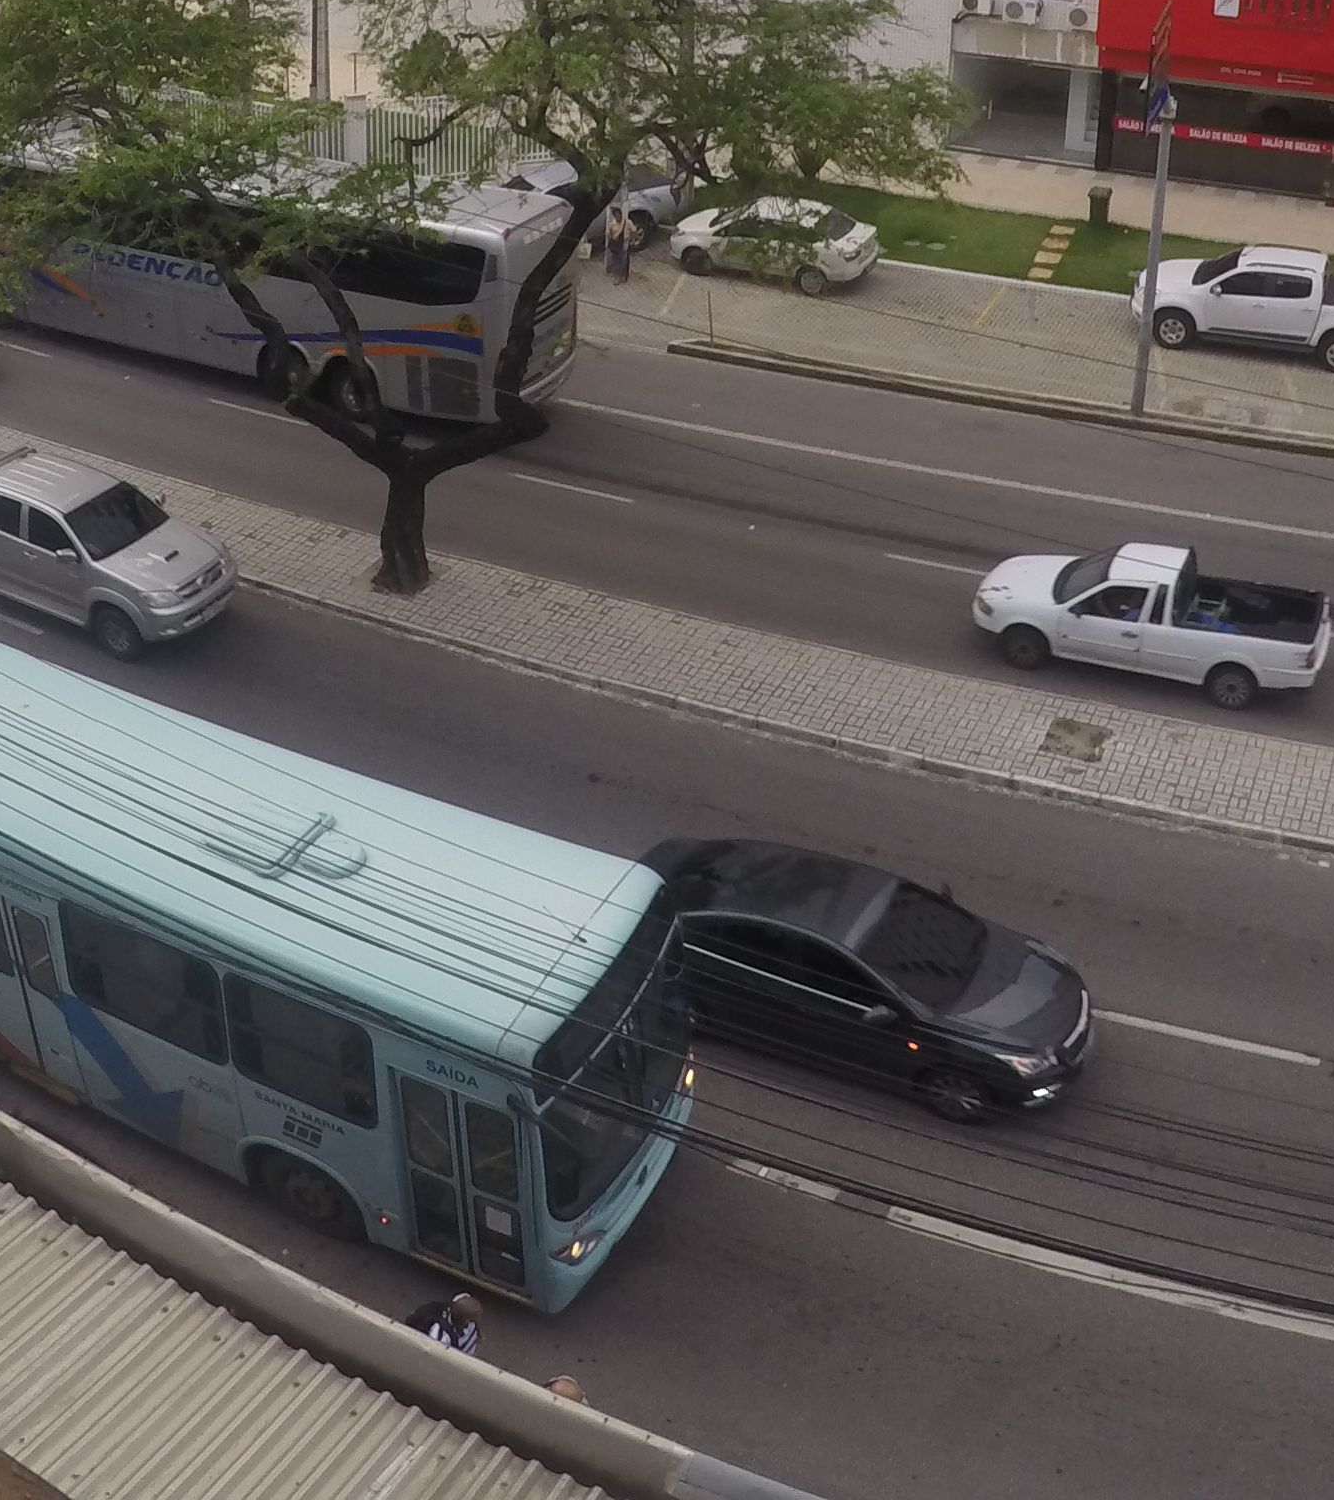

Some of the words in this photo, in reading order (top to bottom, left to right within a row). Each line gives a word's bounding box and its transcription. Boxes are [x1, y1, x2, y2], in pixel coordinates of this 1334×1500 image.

[1189, 127, 1210, 140] SALÃO
[1211, 131, 1221, 141] DE
[1222, 132, 1247, 144] BELEZA
[1261, 137, 1283, 149] SALÃO
[1284, 140, 1293, 150] DE
[1294, 142, 1321, 154] BELEZA
[426, 1059, 479, 1090] SAÍDA
[254, 1090, 298, 1116] SANTA
[301, 1110, 346, 1136] MARIA
